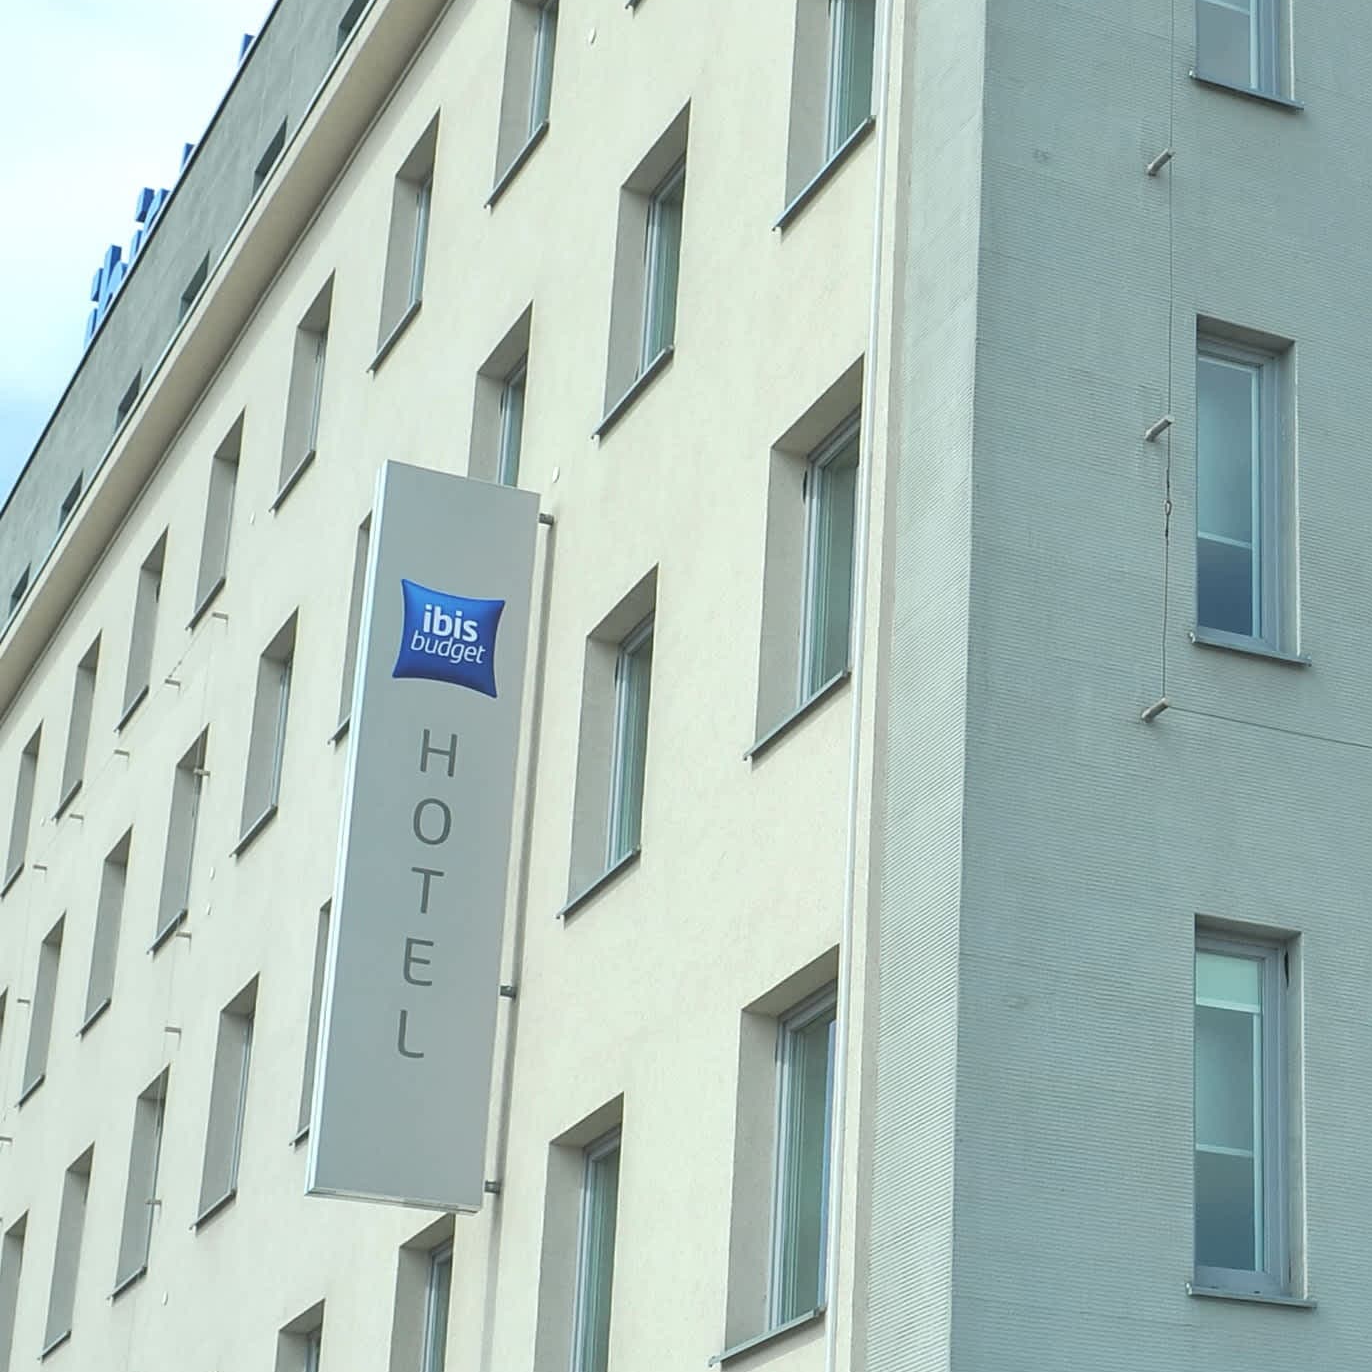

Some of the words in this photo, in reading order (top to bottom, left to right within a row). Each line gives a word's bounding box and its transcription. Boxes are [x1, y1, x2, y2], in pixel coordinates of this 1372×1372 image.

[423, 604, 478, 642] ibis
[411, 630, 486, 664] budget
[398, 729, 457, 1058] HOTEL
